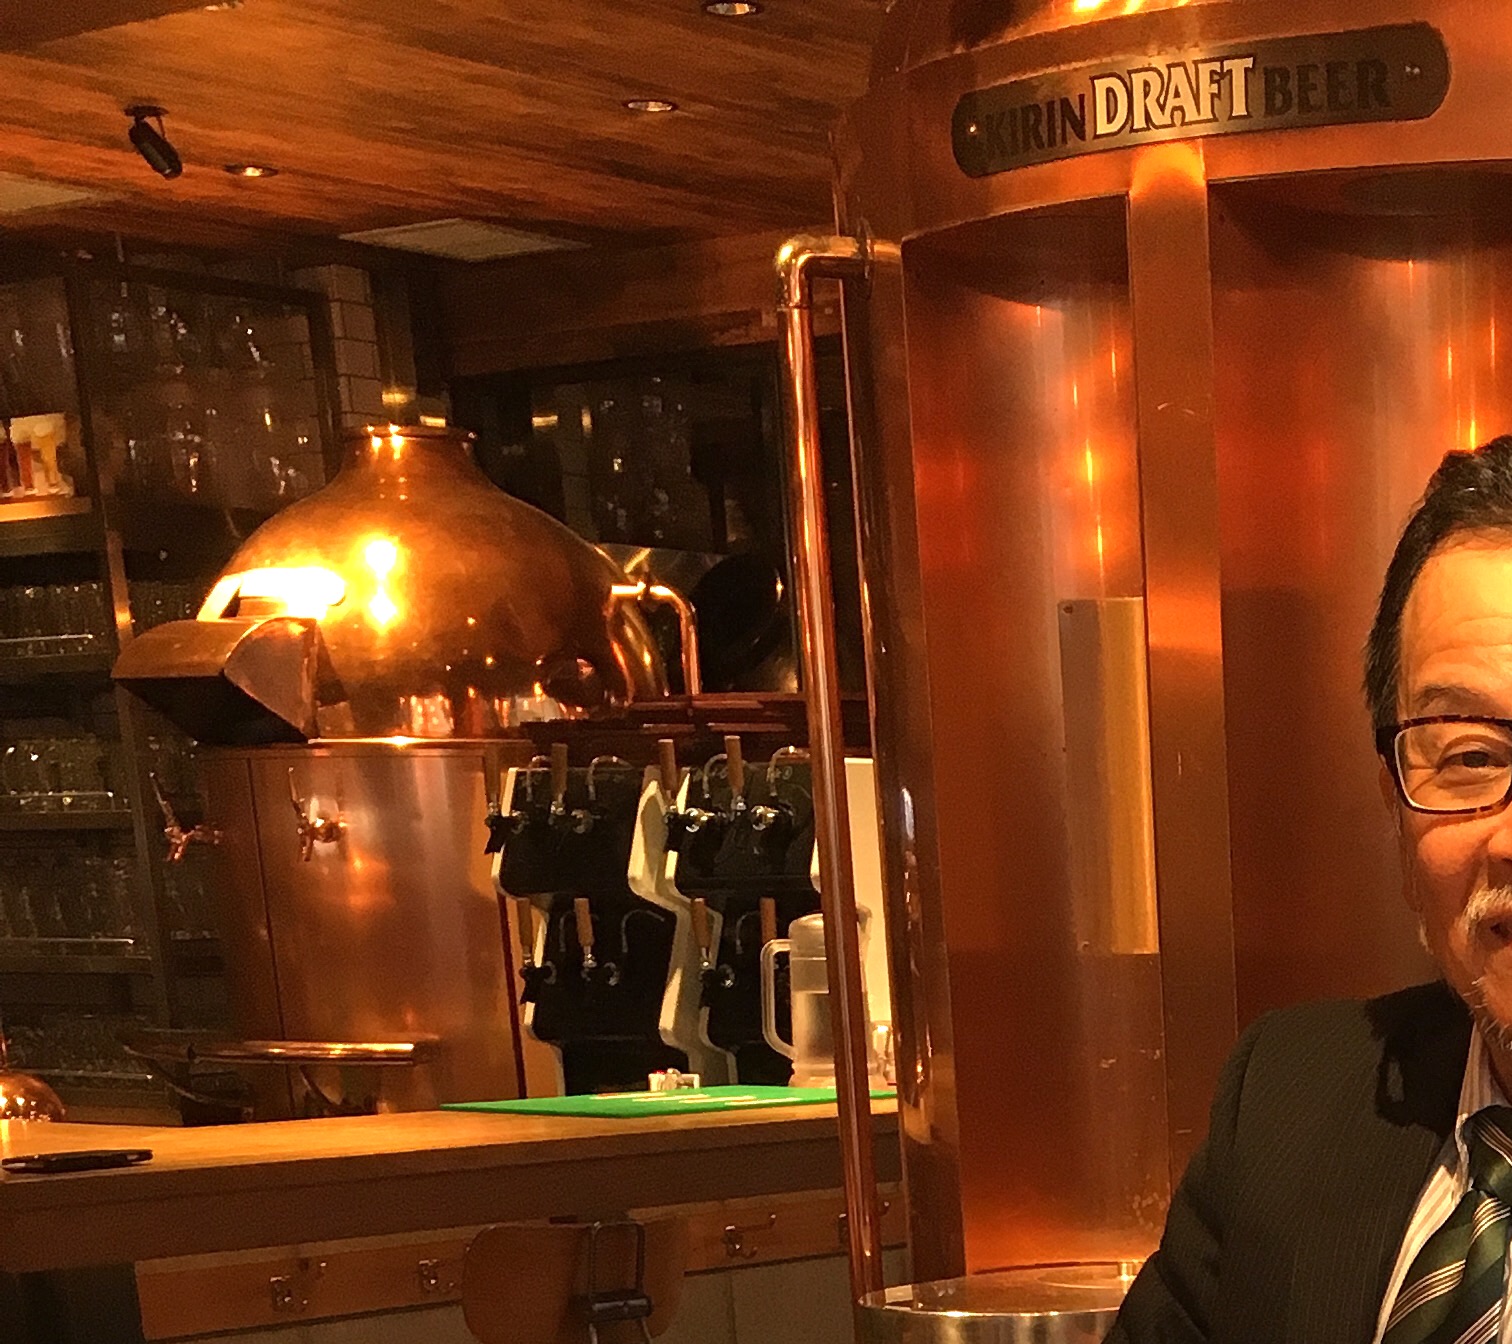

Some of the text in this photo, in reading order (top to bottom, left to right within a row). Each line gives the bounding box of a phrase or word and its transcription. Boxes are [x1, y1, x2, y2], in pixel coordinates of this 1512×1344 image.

[987, 56, 1391, 155] KIRIN DRAFT BEER
